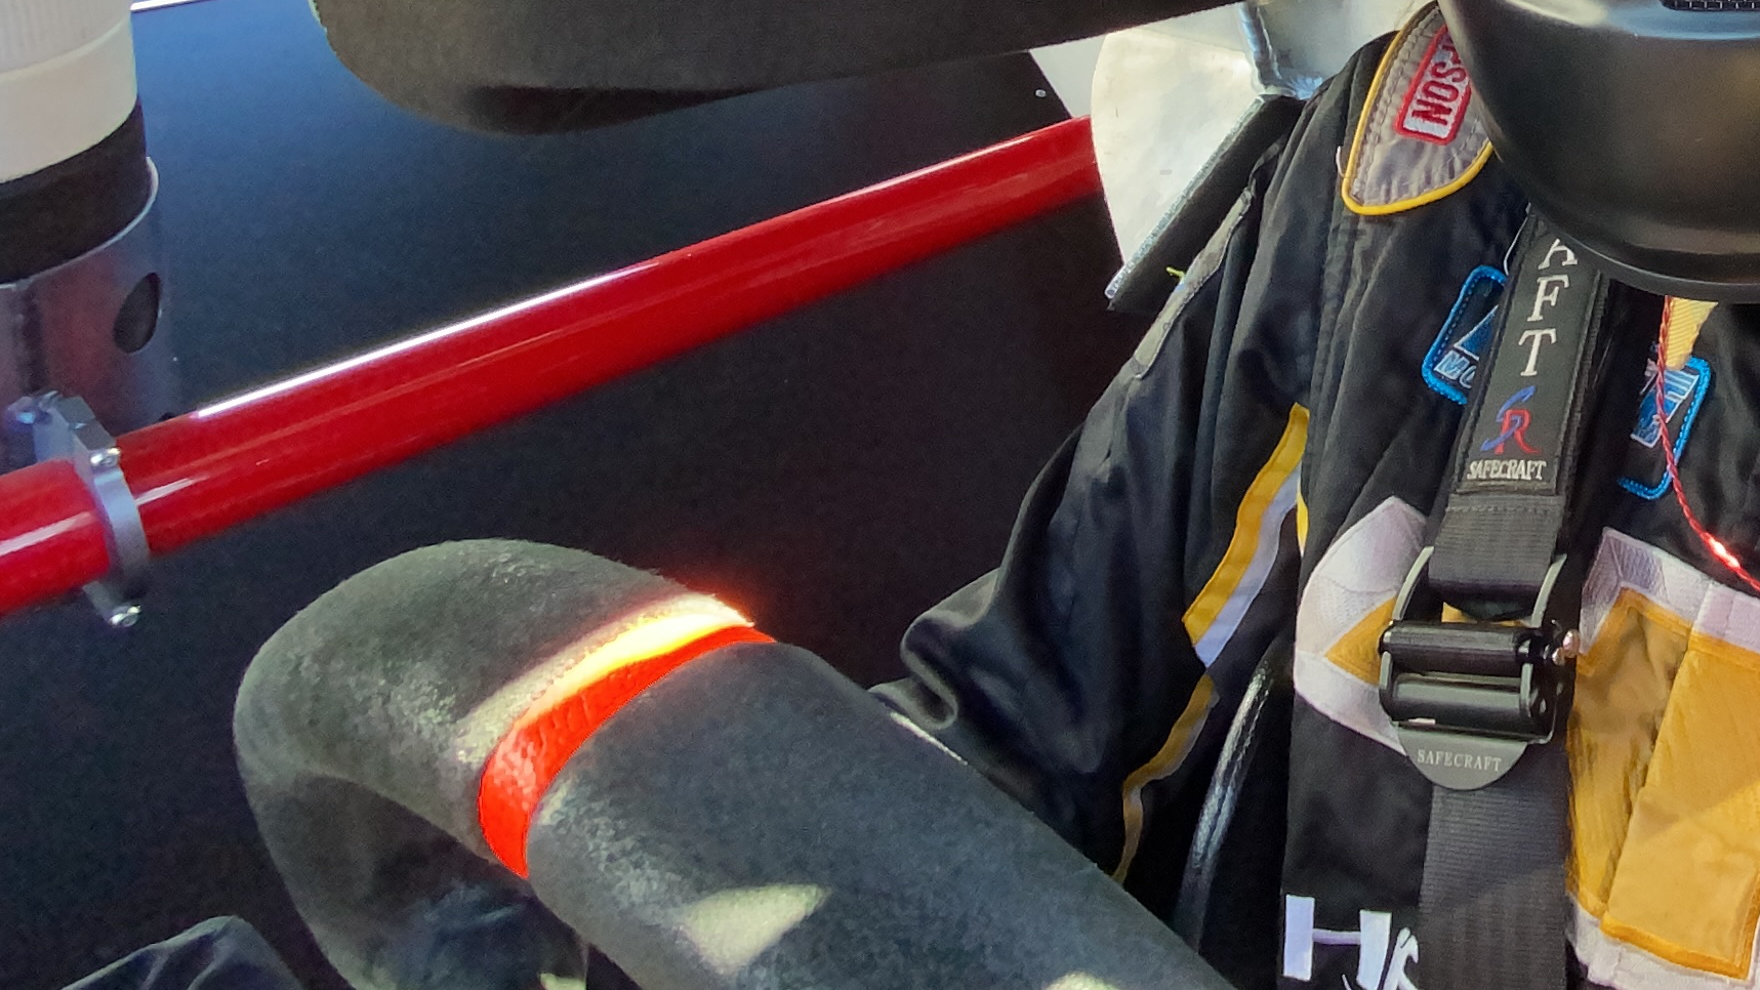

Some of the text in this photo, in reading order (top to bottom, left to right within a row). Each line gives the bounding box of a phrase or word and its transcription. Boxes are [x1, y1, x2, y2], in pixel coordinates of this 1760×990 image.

[1518, 238, 1578, 377] AFT
[1467, 459, 1547, 481] SAFECRAFT
[1417, 749, 1502, 772] SAFECRAFT
